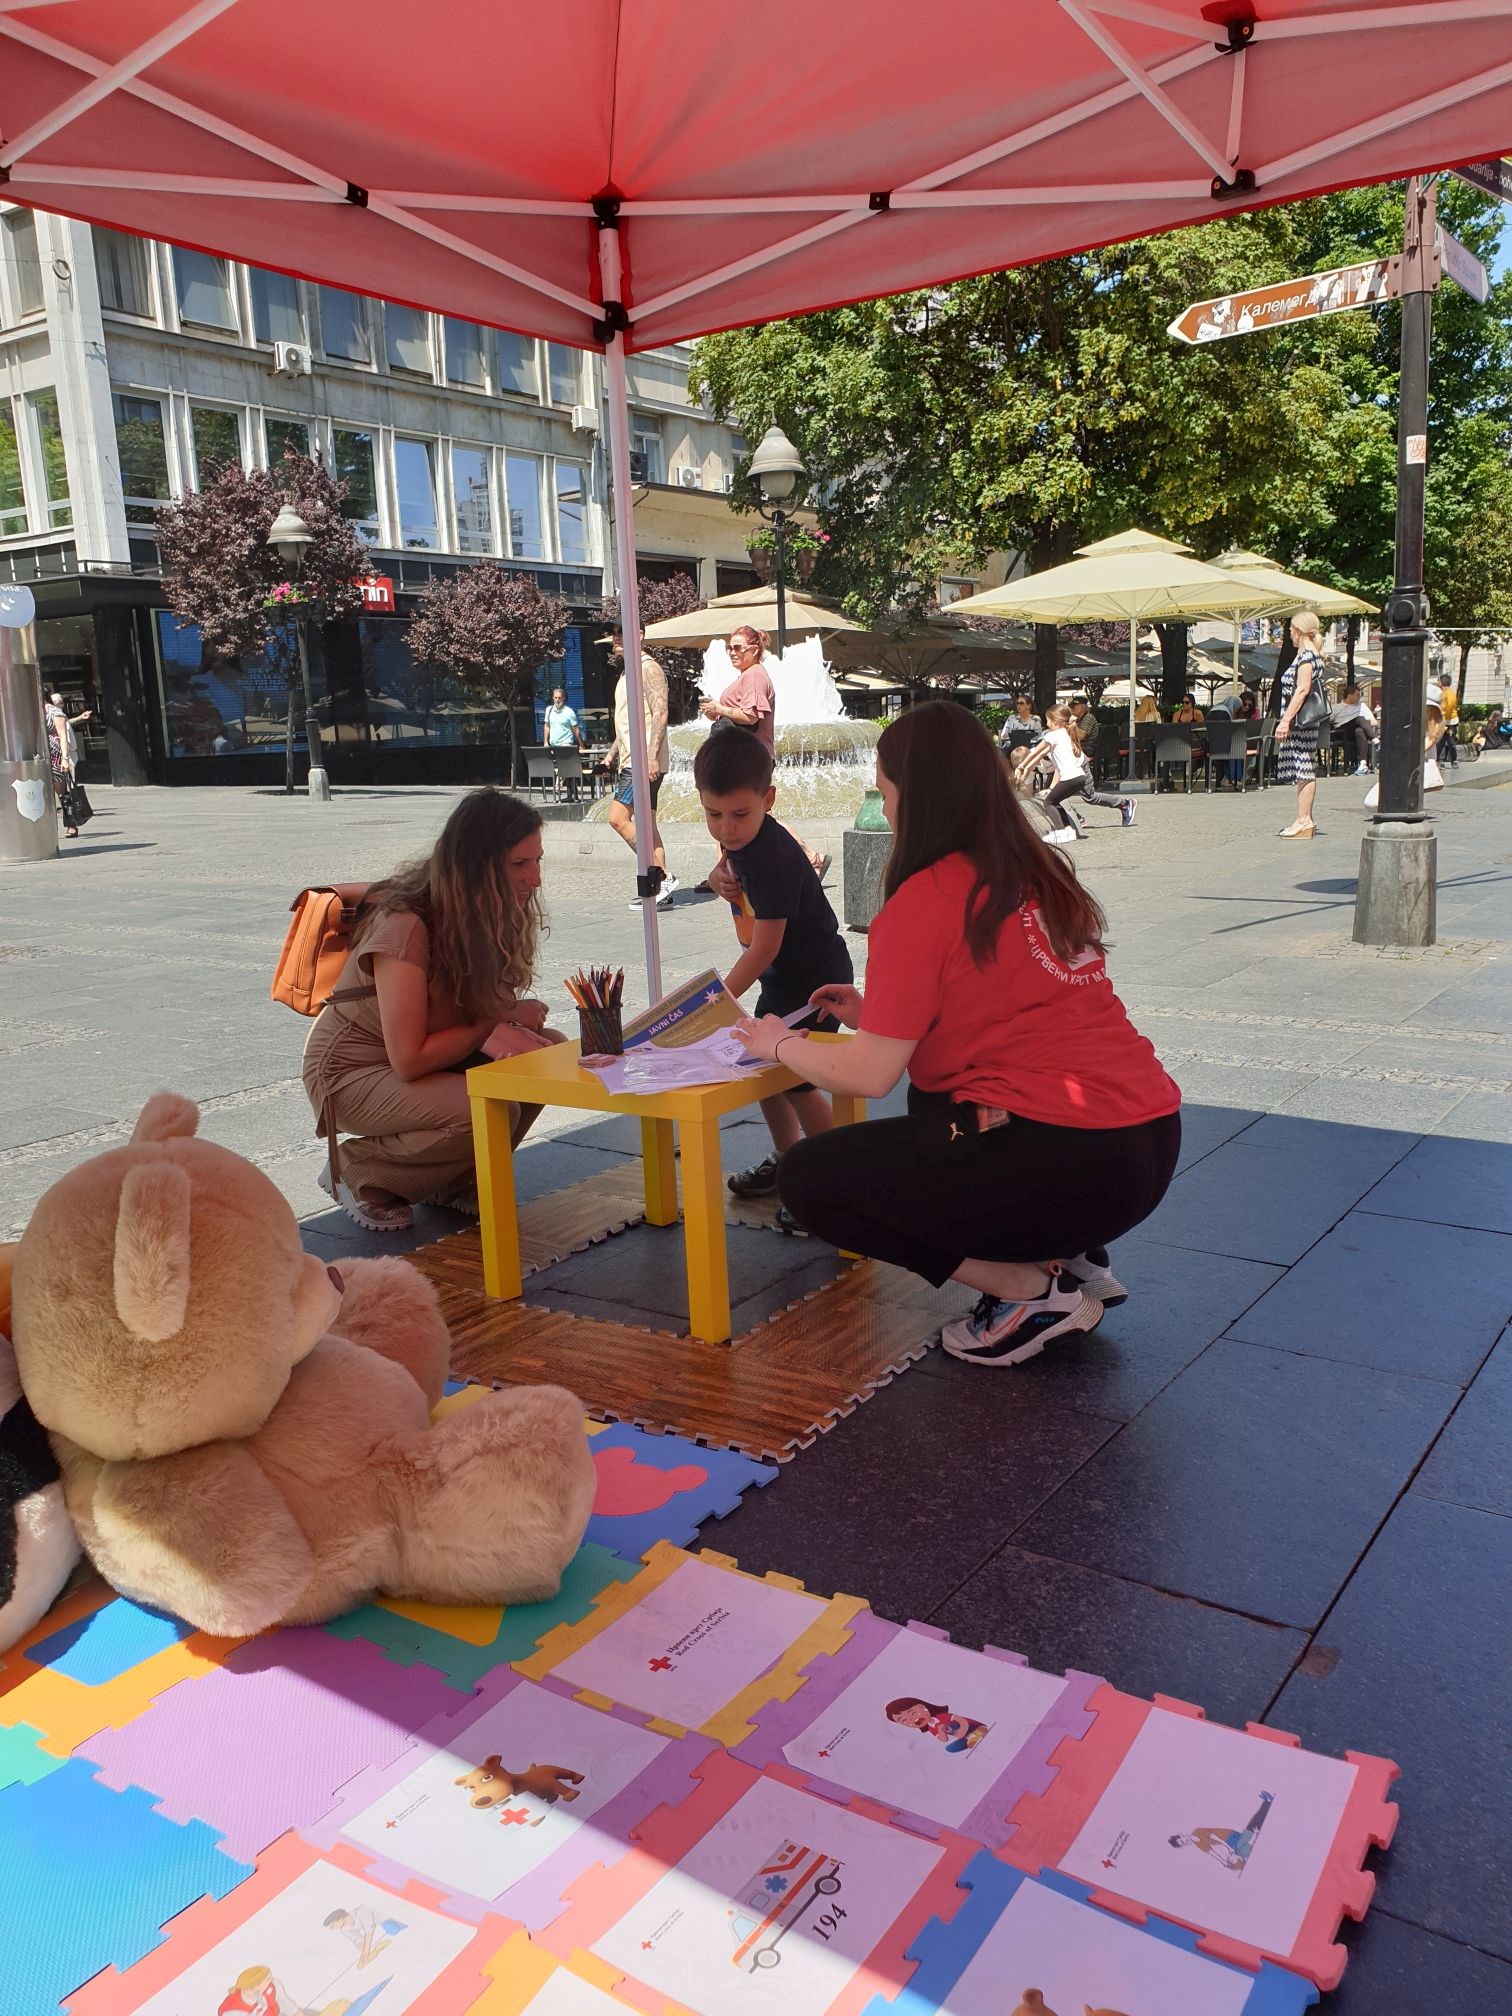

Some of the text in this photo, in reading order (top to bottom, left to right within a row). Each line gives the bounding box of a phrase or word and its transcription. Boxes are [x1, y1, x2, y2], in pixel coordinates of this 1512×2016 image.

[1241, 292, 1321, 318] Калемегд
[1030, 944, 1068, 982] ЦРВЕНИ
[648, 1018, 670, 1035] JAVNI
[668, 1009, 684, 1022] ČAS
[675, 1645, 690, 1656] Red
[687, 1632, 706, 1646] Cross
[710, 1611, 730, 1626] Serbia
[811, 1903, 847, 1942] 194
